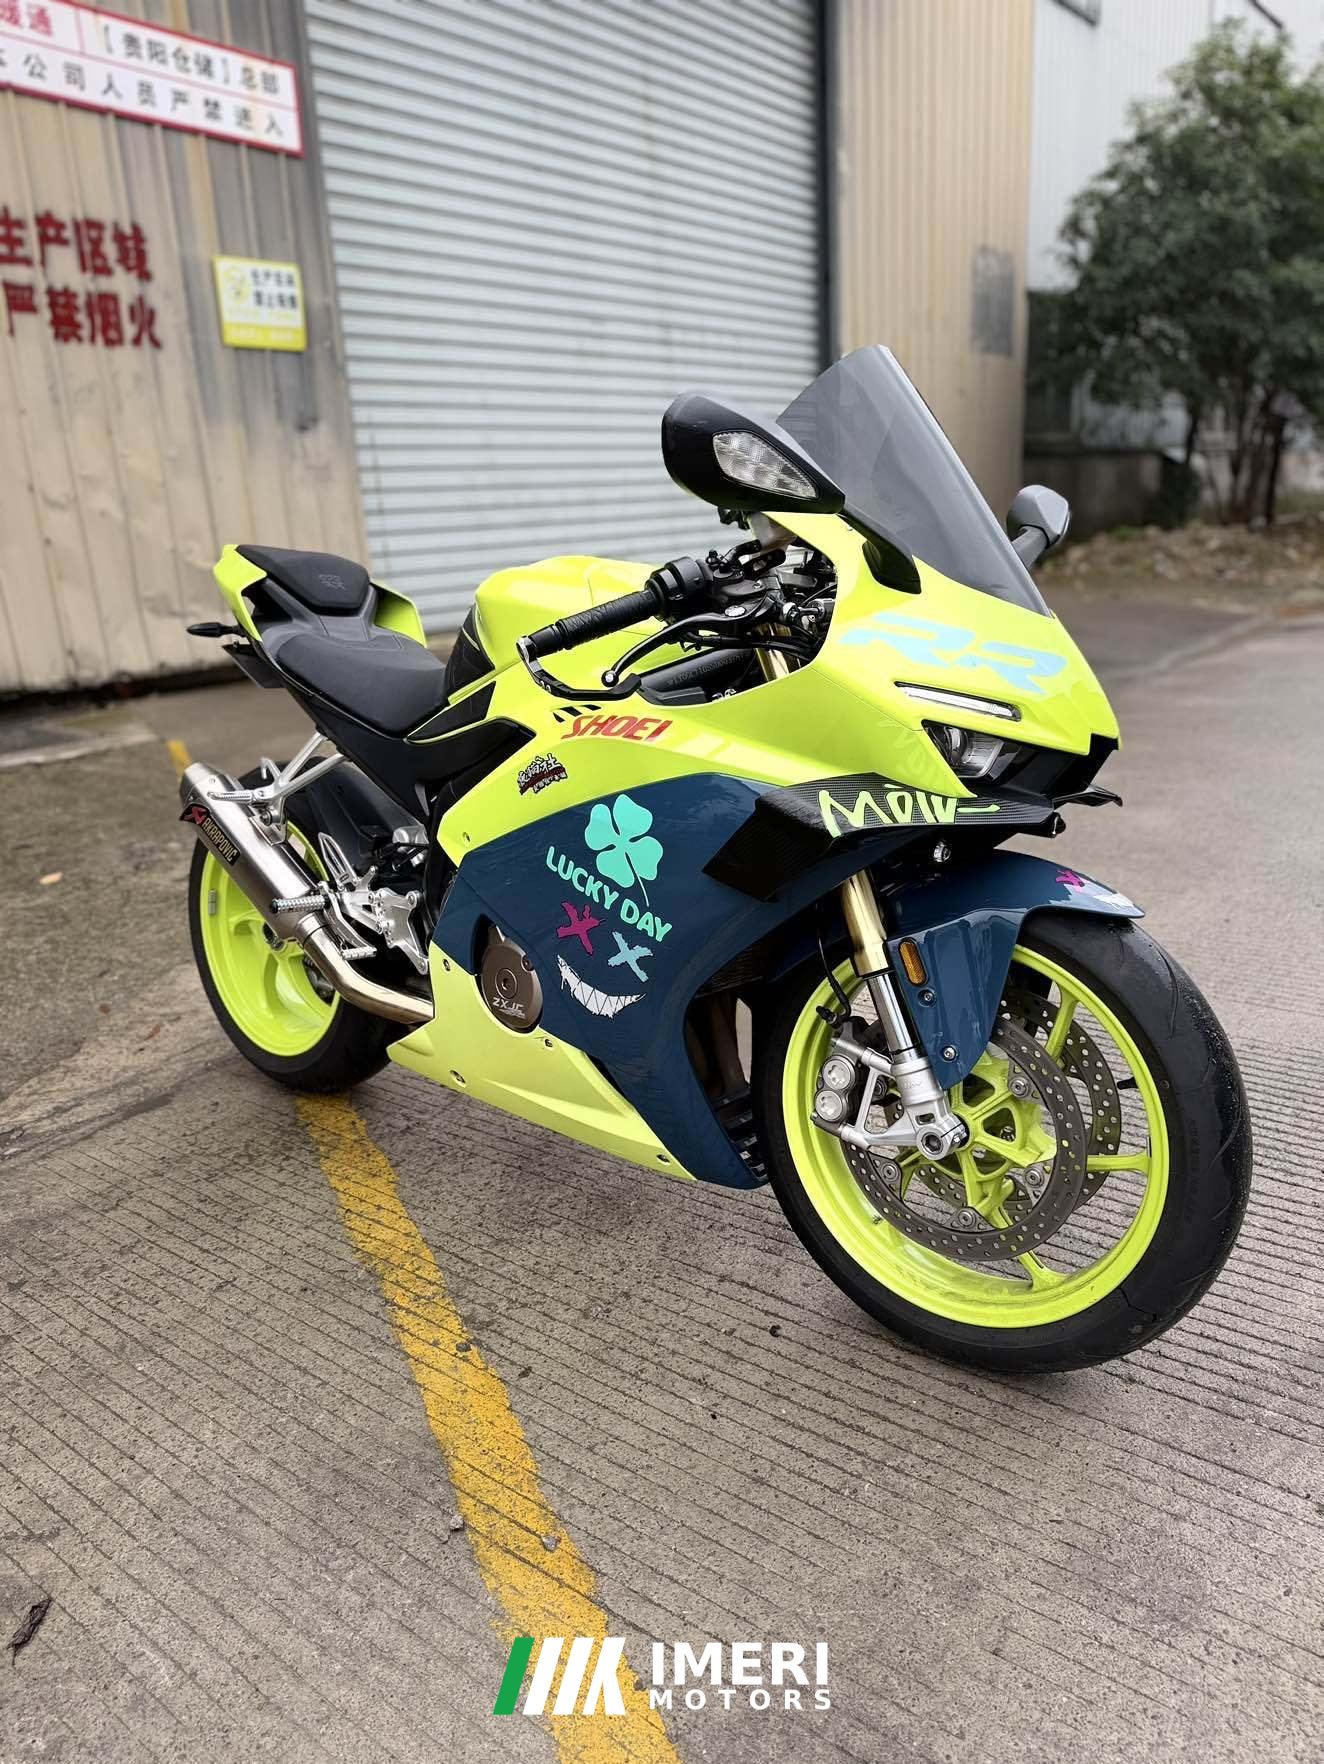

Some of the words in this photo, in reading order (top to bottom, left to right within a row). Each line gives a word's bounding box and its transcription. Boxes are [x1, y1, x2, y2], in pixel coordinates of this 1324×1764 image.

[561, 714, 673, 742] SHOEI
[545, 845, 620, 911] LUCKY
[619, 898, 673, 943] DAY
